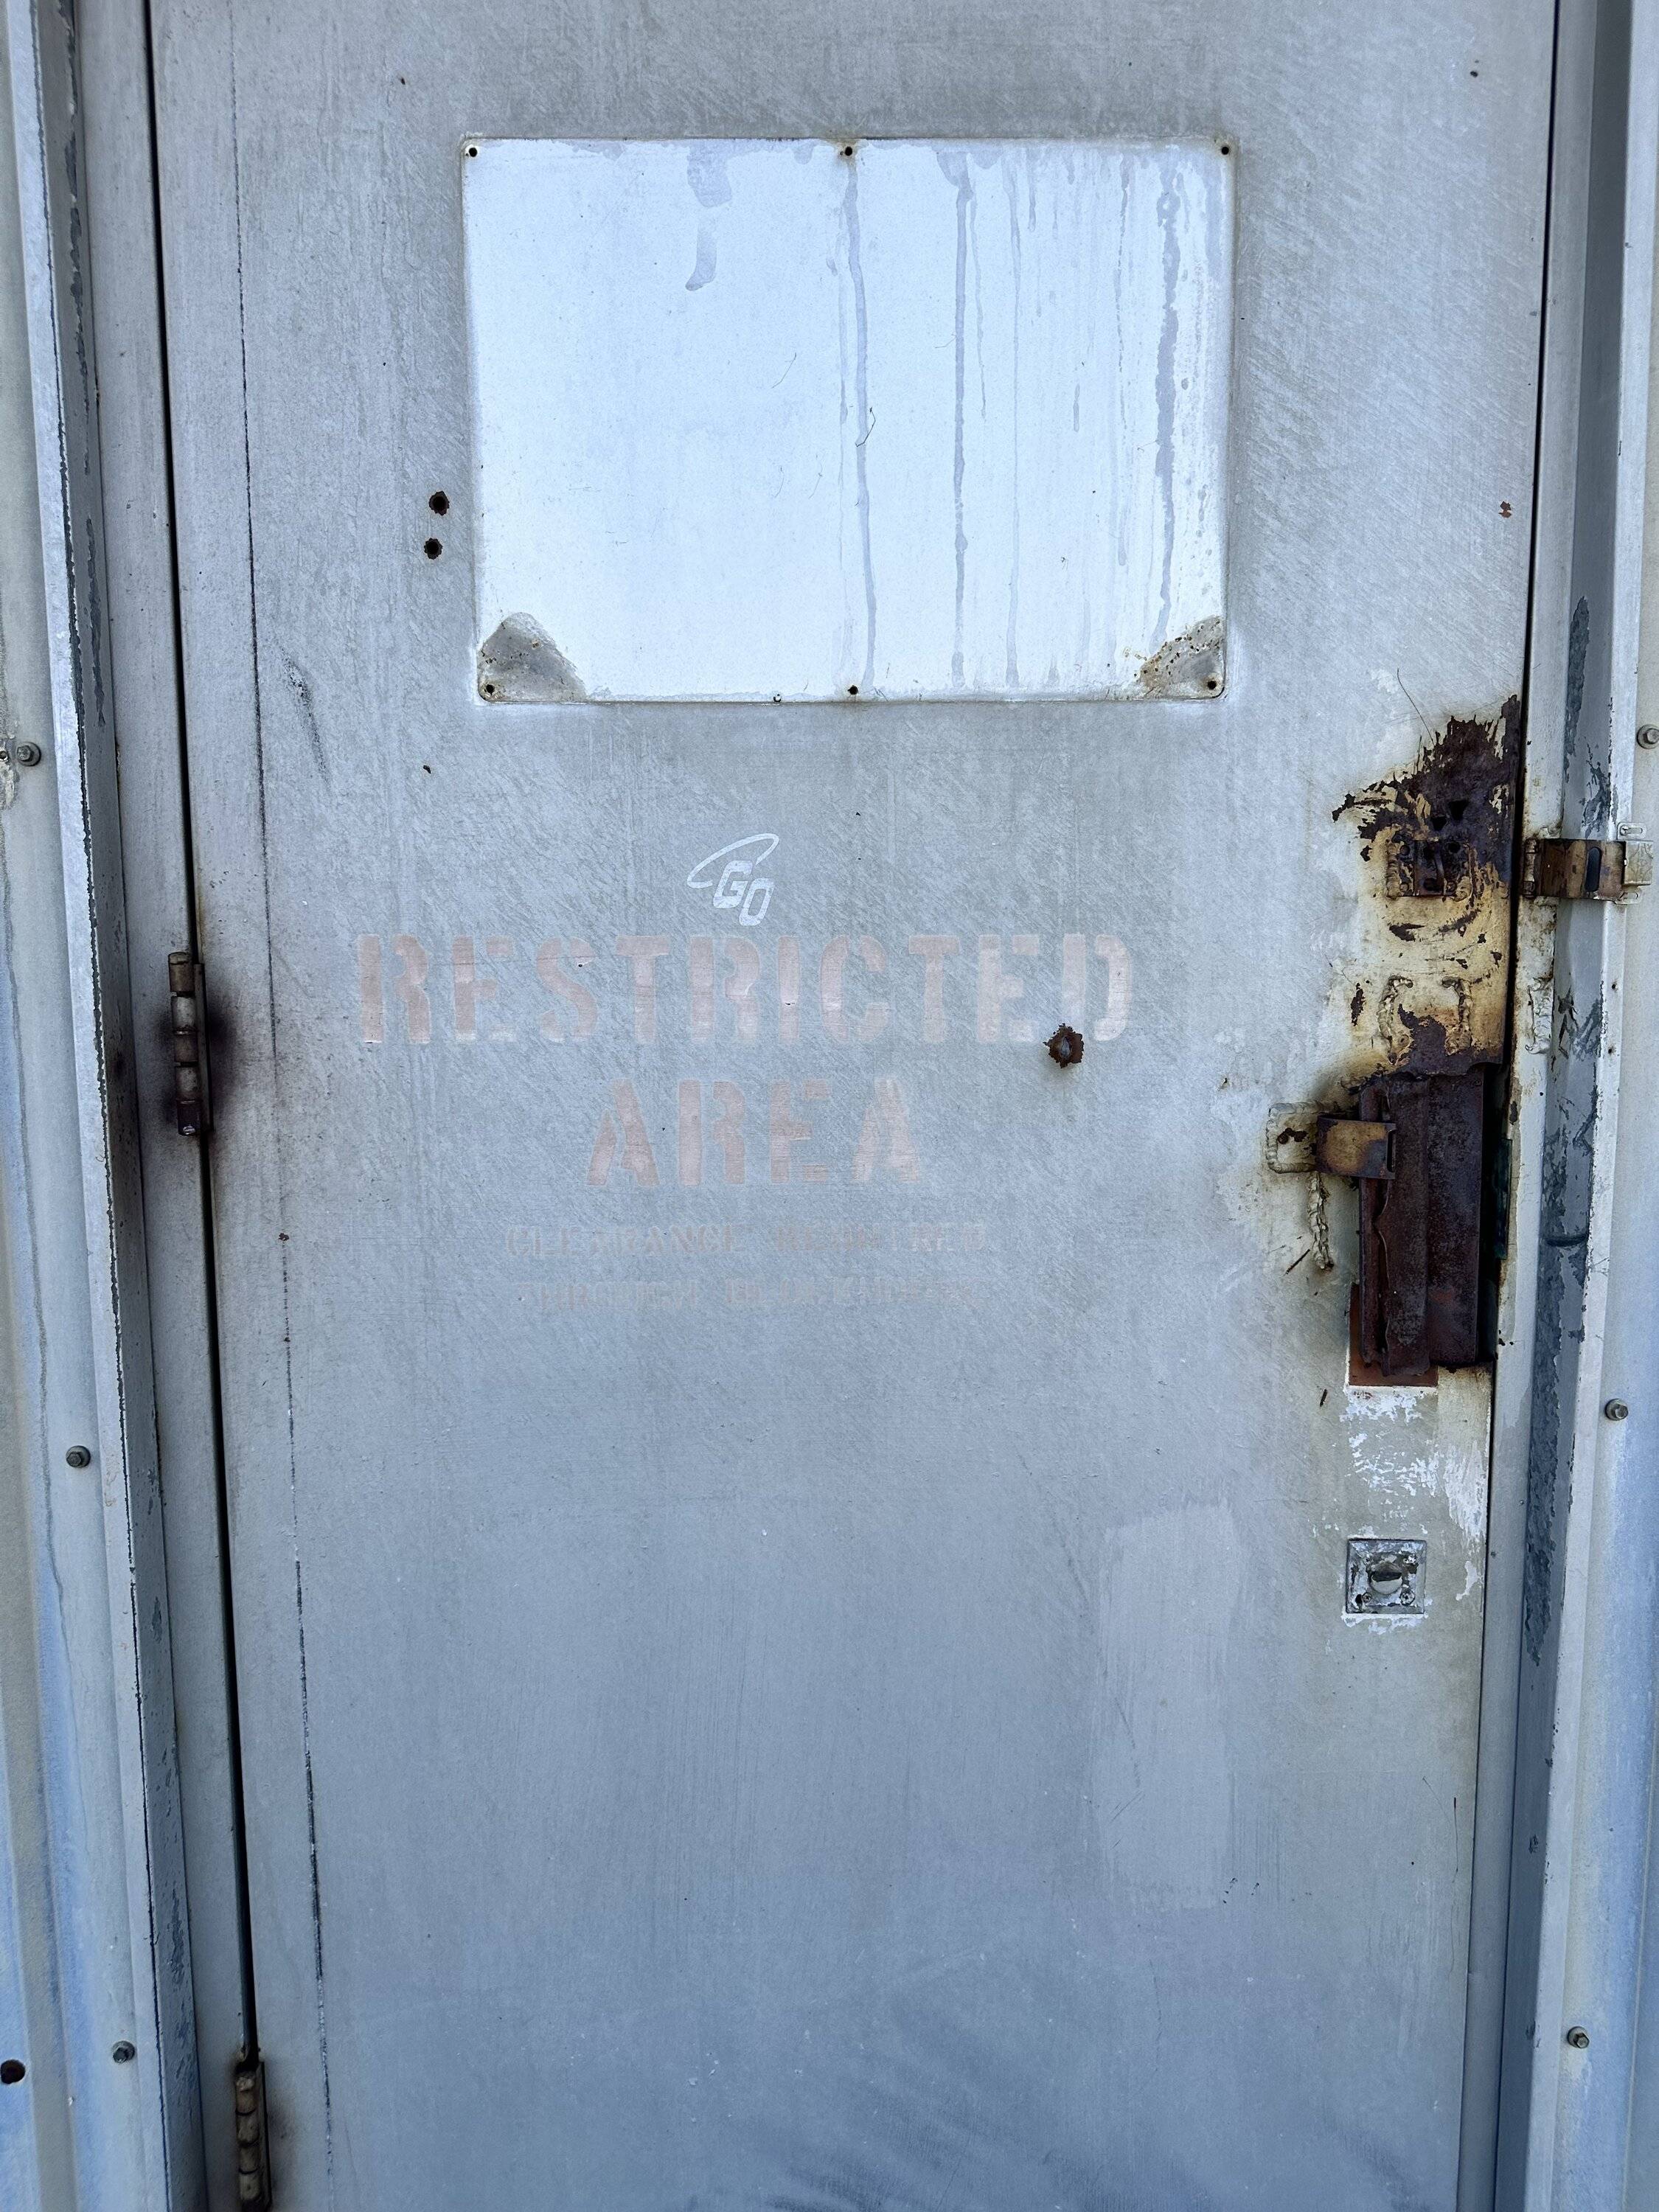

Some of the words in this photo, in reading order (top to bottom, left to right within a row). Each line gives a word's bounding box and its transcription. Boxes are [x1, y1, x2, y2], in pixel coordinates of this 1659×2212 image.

[357, 932, 1133, 1045] RESTRICTED
[588, 1078, 922, 1186] AREA
[506, 1224, 751, 1256] CLEARANCE
